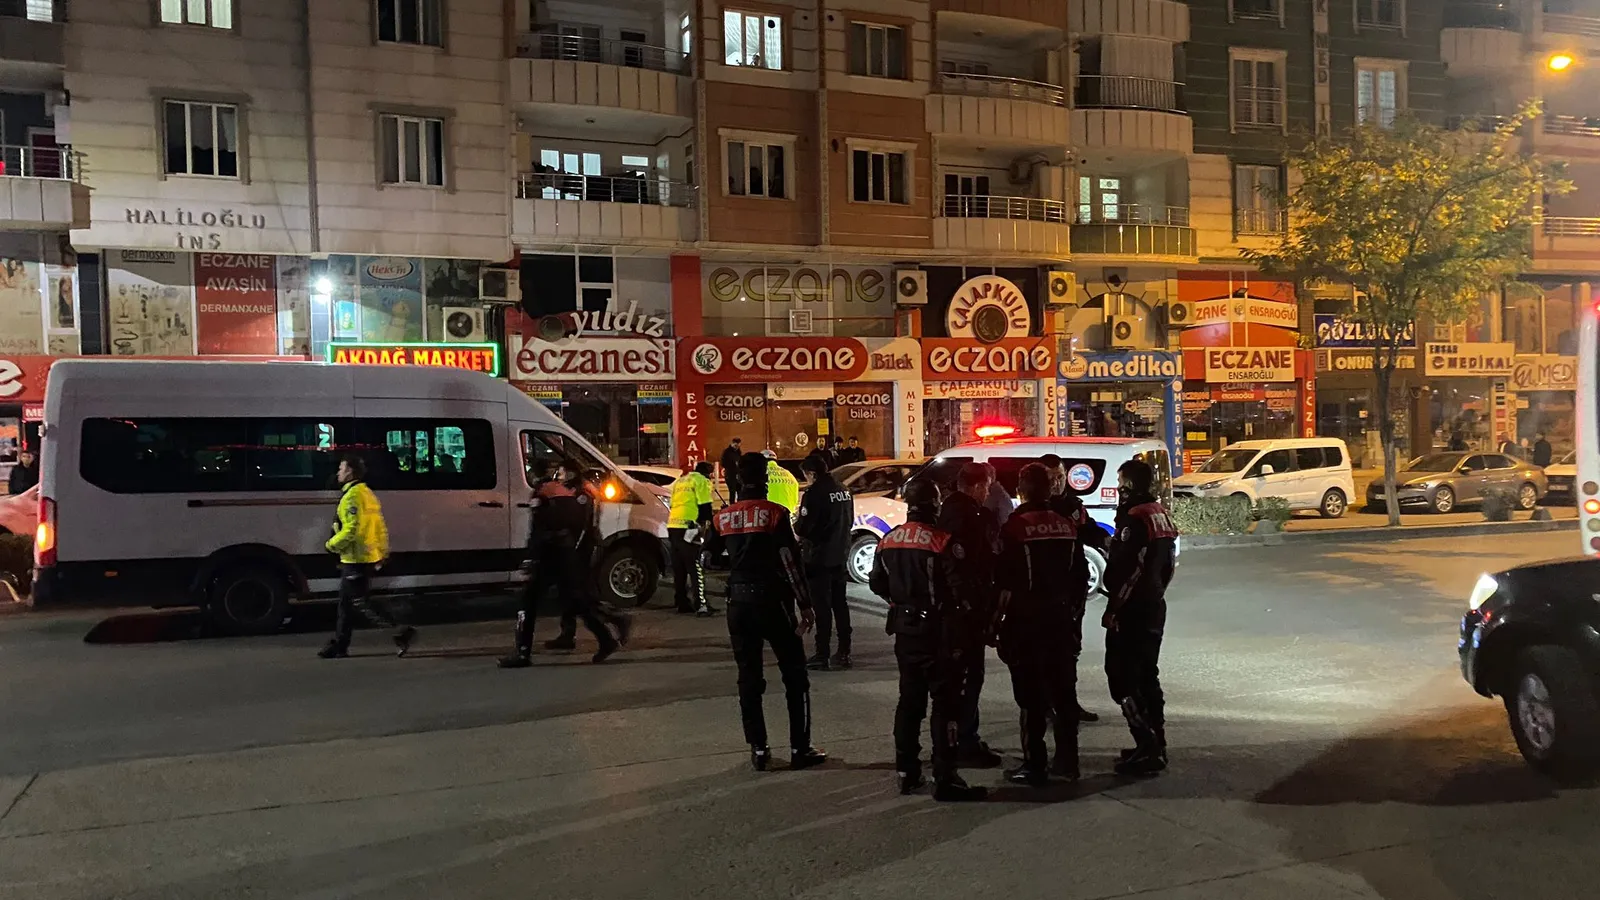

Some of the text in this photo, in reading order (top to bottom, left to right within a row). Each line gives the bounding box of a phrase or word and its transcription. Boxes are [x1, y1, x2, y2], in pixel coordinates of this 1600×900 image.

[126, 207, 266, 230] HALİLOĞLU
[200, 253, 270, 269] ECZANE
[204, 275, 268, 294] AVAŞİN
[708, 266, 886, 303] eczane
[951, 282, 1027, 330] ÇALAPKULU
[1195, 303, 1228, 321] ZANE
[334, 346, 493, 371] AKDAĞ MARKET
[516, 340, 673, 374] eczanesi
[732, 347, 856, 371] eczane
[929, 345, 1051, 373] eczane
[1087, 354, 1182, 378] medikal
[1209, 350, 1292, 370] ECZANE
[1446, 355, 1514, 370] MEDİKAL
[1228, 369, 1275, 380] ENSAROĞLU
[704, 394, 764, 408] eczane
[836, 391, 891, 407] eczane
[850, 407, 877, 419] bilek
[686, 392, 700, 468] ECZAN
[1173, 392, 1182, 467] MEDİKAL
[1103, 488, 1115, 497] 112
[718, 506, 769, 531] POLİS
[1025, 520, 1071, 537] POLİS
[882, 526, 933, 545] POLİS
